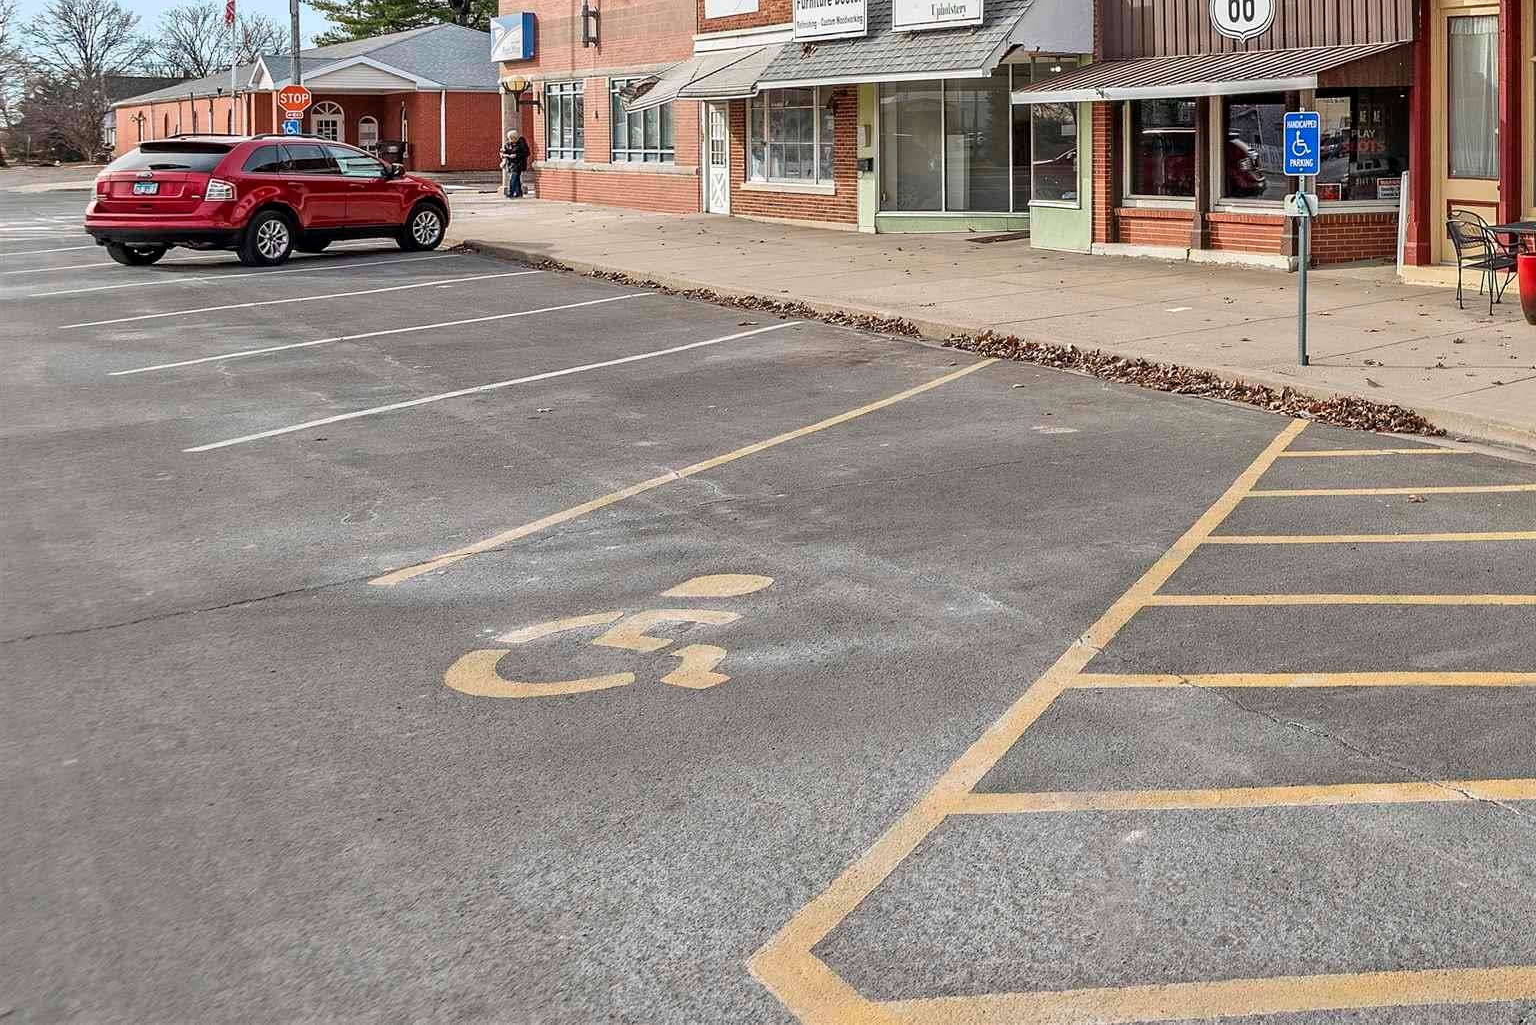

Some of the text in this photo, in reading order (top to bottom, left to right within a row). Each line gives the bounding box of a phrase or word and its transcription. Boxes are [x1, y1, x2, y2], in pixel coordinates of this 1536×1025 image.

[931, 2, 967, 21] Upholstery
[280, 93, 309, 104] STOP
[1286, 120, 1317, 129] HANDICAPPED
[1290, 159, 1313, 167] PARKING
